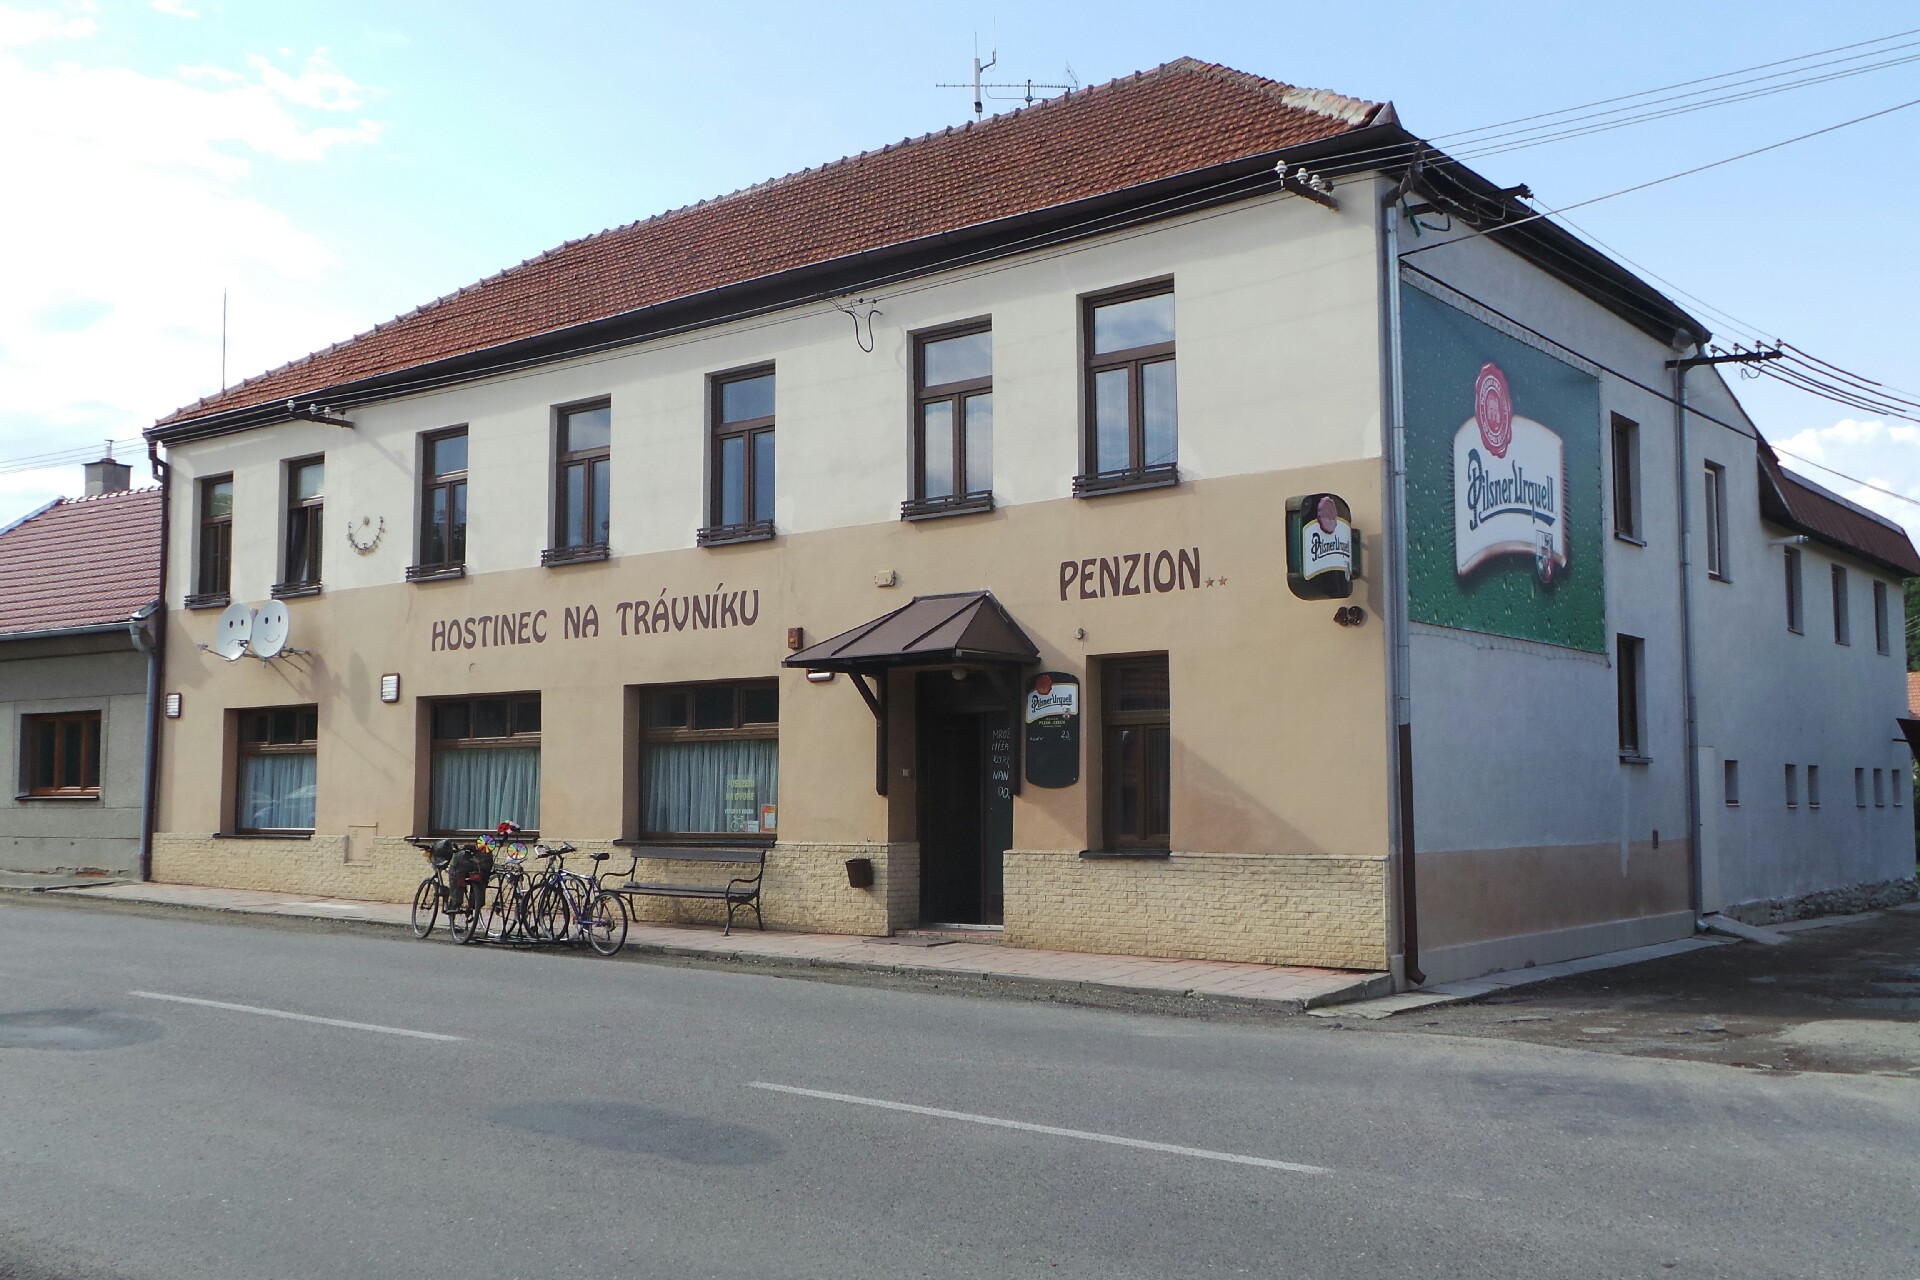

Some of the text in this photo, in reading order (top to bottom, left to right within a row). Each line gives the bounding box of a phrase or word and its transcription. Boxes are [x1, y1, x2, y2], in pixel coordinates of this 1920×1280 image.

[1467, 448, 1554, 531] Pilsner Urquell
[1311, 532, 1350, 561] Pilsner Urquell
[1059, 547, 1200, 601] PENZION
[431, 582, 759, 652] HOSTINEC NA TRÁVNÍKU
[1031, 694, 1072, 713] Pilsner Urquell
